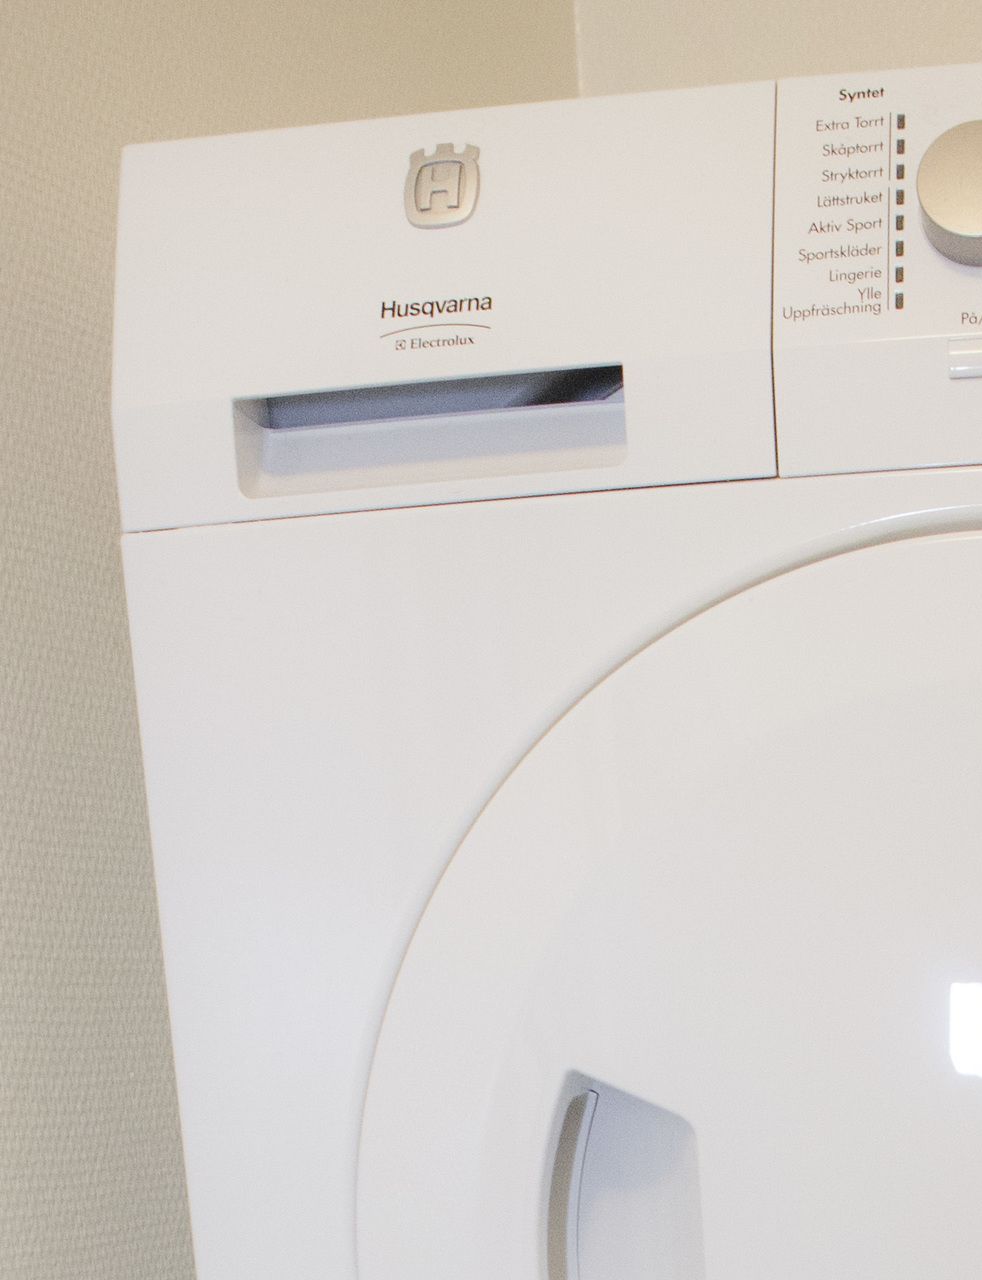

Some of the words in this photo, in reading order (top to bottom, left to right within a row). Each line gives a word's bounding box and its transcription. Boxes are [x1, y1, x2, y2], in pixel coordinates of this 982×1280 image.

[839, 87, 884, 103] Syntet
[816, 120, 849, 132] Extra
[856, 117, 884, 128] Torrt
[822, 142, 884, 158] Skåptorrt
[821, 168, 883, 183] Stryktorrt
[817, 192, 883, 208] Lättstruket
[808, 221, 841, 234] Aktiv
[847, 218, 882, 234] Sport
[799, 244, 882, 263] Sportskläder
[829, 267, 882, 284] Lingerie
[858, 288, 882, 300] Ylle
[380, 295, 492, 319] Husqvarna
[783, 302, 881, 322] Uppfräschning
[410, 335, 474, 350] Electrolux
